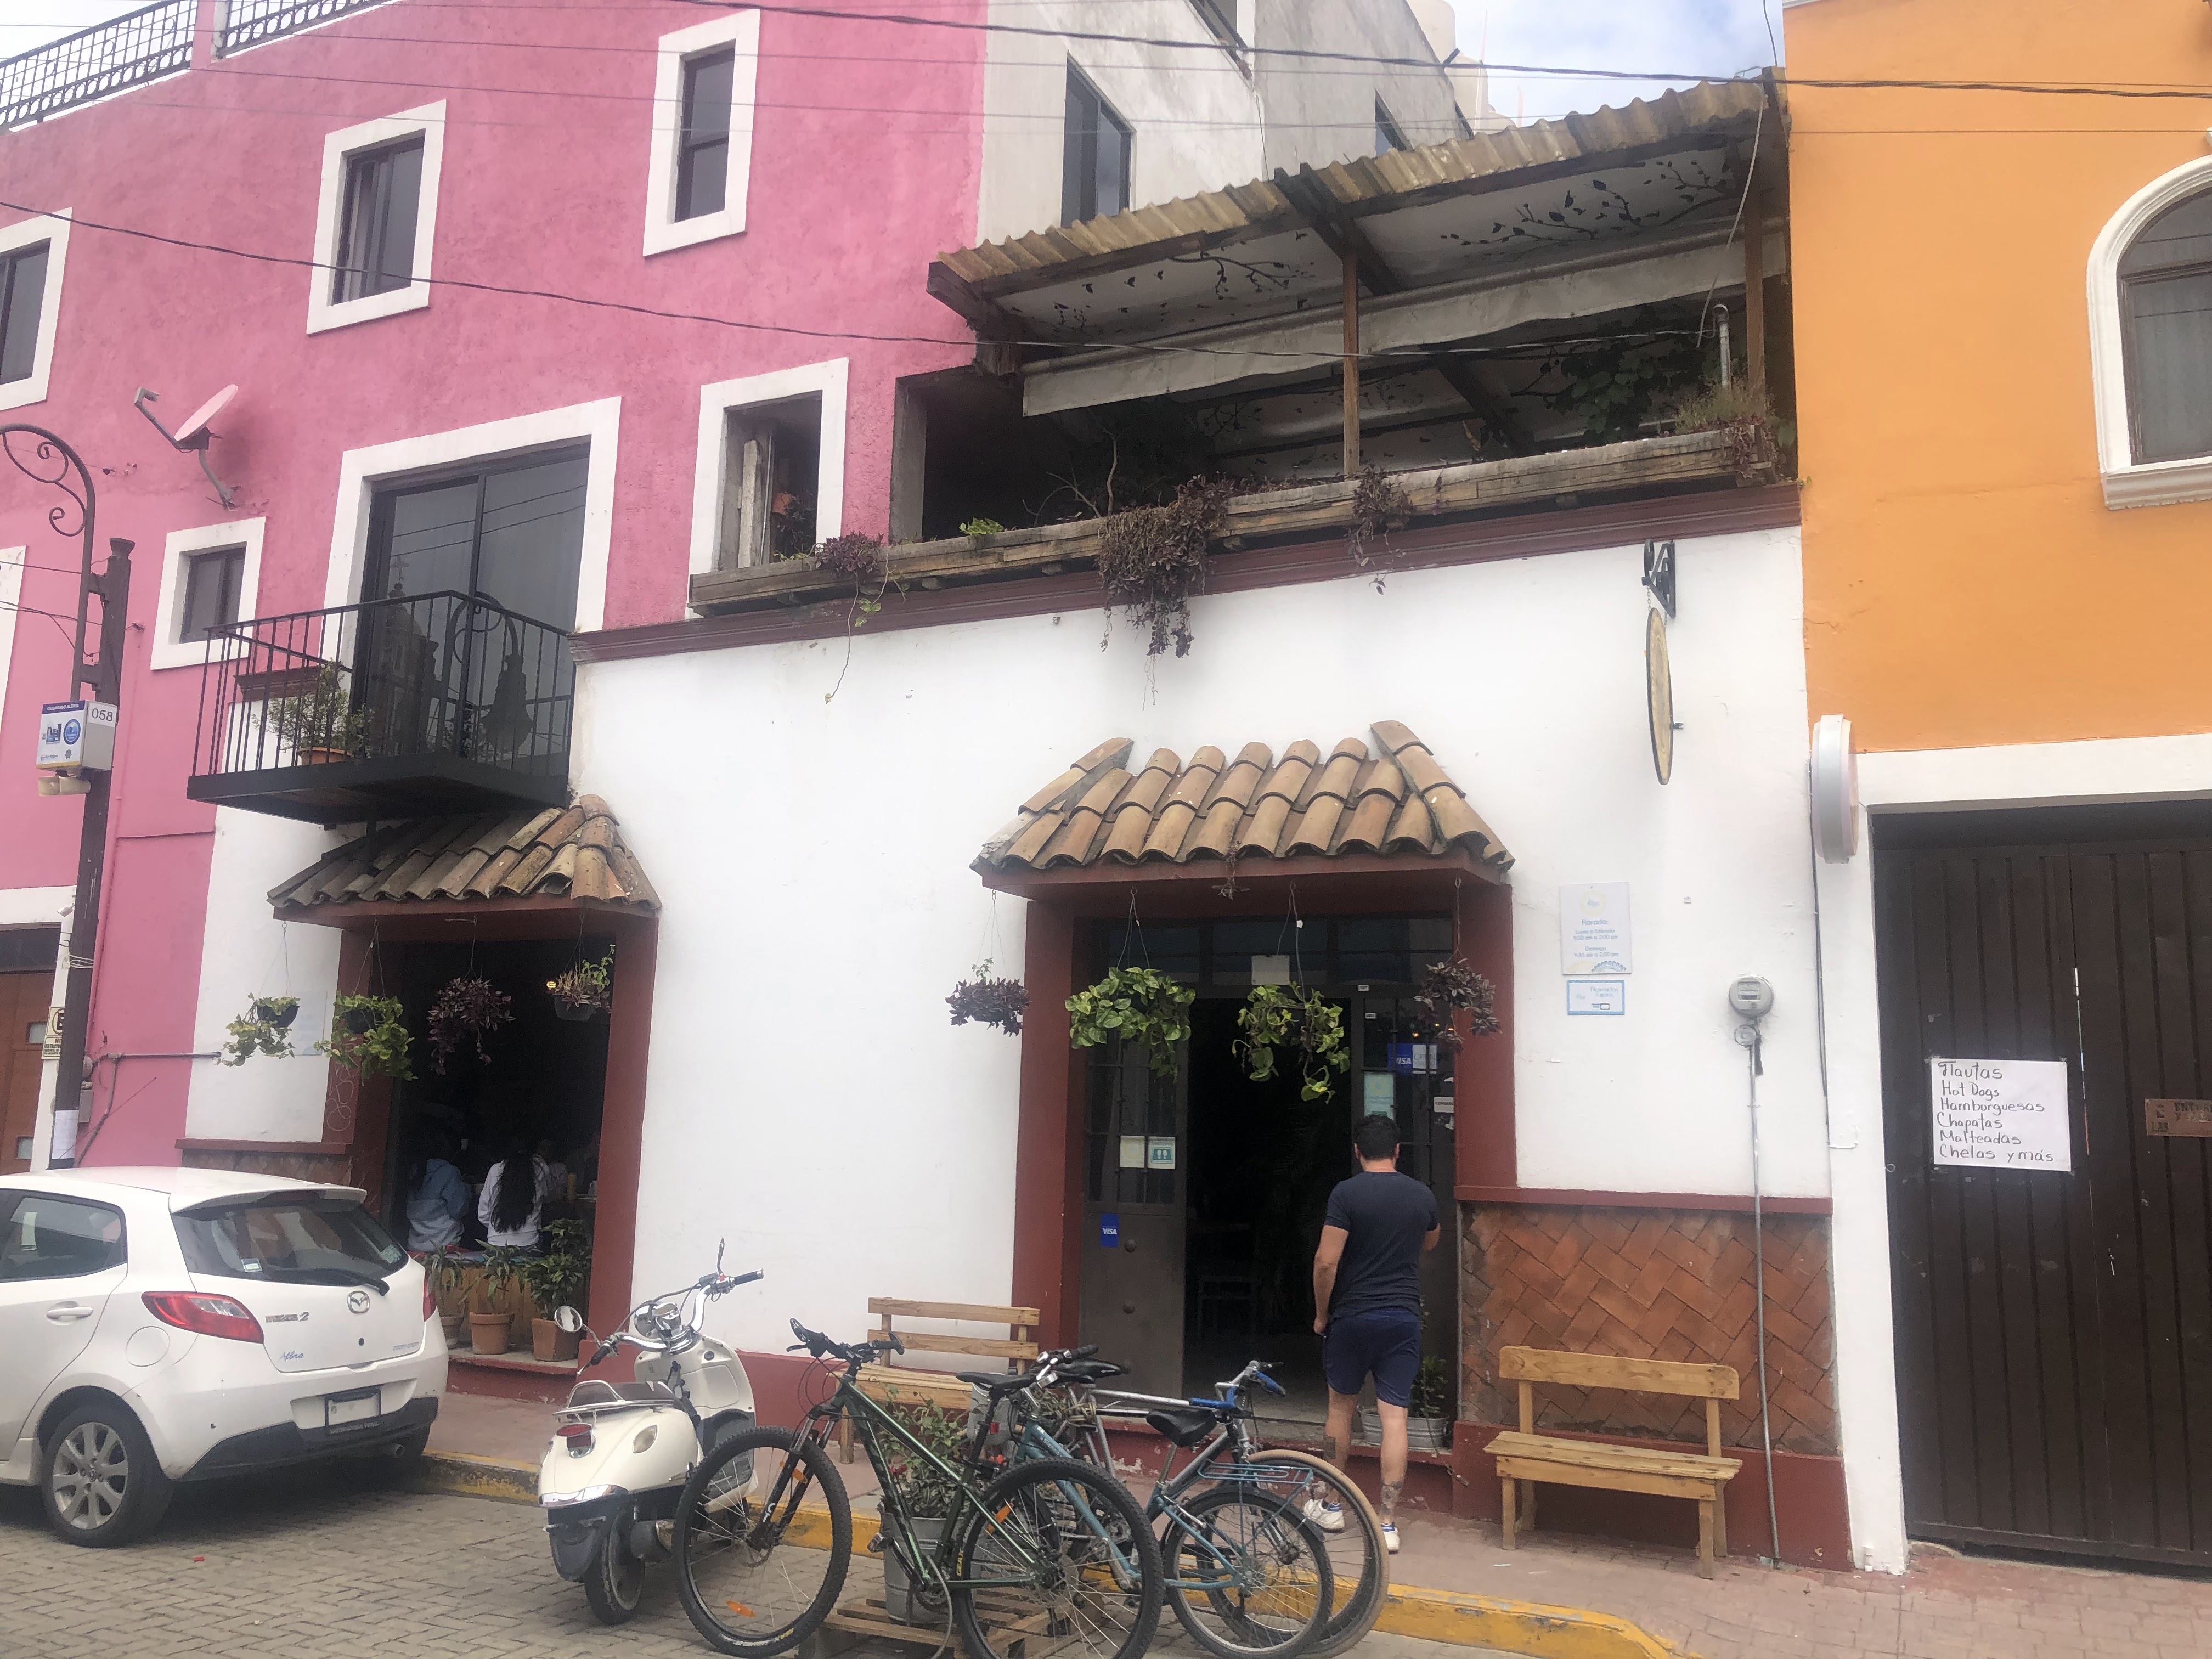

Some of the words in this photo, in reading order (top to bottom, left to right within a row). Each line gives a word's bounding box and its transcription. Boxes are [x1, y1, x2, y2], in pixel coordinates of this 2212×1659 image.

[92, 708, 113, 722] 058
[1938, 1061, 2003, 1080] Flautas
[1942, 1080, 1965, 1097] Hot
[1968, 1081, 2000, 1101] Dogs
[1941, 1097, 2045, 1116] Hamburguesas
[1937, 1111, 2002, 1133] Chapatas
[1940, 1130, 2022, 1144] Malteadas
[1939, 1143, 1996, 1159] Chelas
[2007, 1152, 2015, 1163] y
[2018, 1149, 2054, 1162] más
